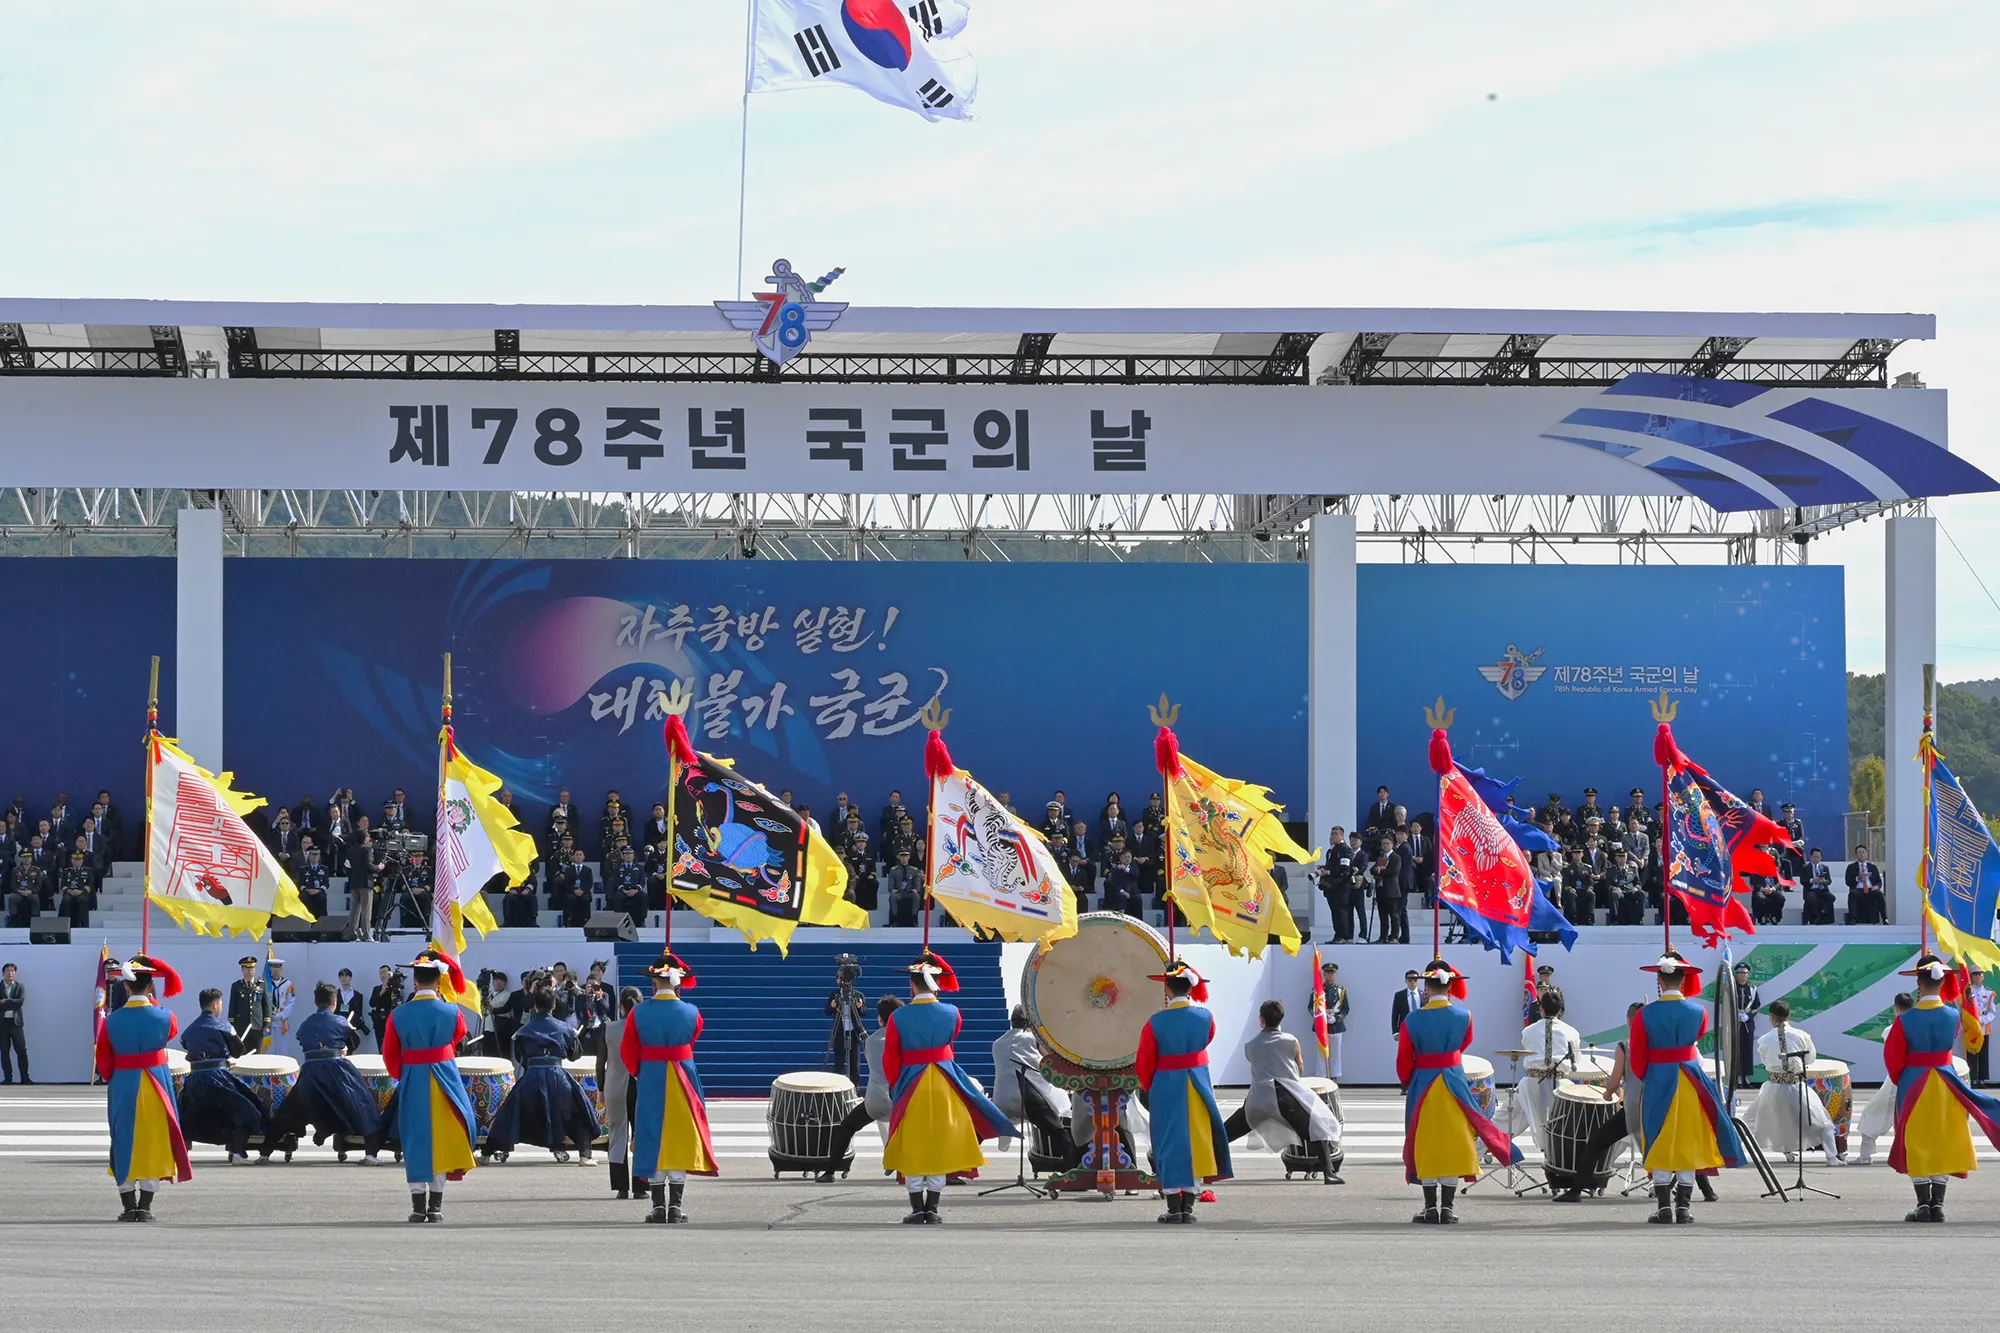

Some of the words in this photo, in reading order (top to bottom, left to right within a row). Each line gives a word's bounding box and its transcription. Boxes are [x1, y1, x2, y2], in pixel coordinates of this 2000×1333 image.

[751, 291, 806, 349] 78
[389, 405, 746, 470] 제78주년
[805, 408, 1030, 471] 국군의
[1090, 410, 1151, 471] 날
[615, 604, 780, 652] 자주국방
[1496, 662, 1526, 690] 78
[1554, 666, 1623, 684] 제78주년
[1629, 666, 1677, 684] 국군의
[1683, 667, 1700, 684] 날
[1572, 685, 1601, 694] Republic
[1684, 686, 1698, 694] Day
[808, 666, 949, 740] 국군
